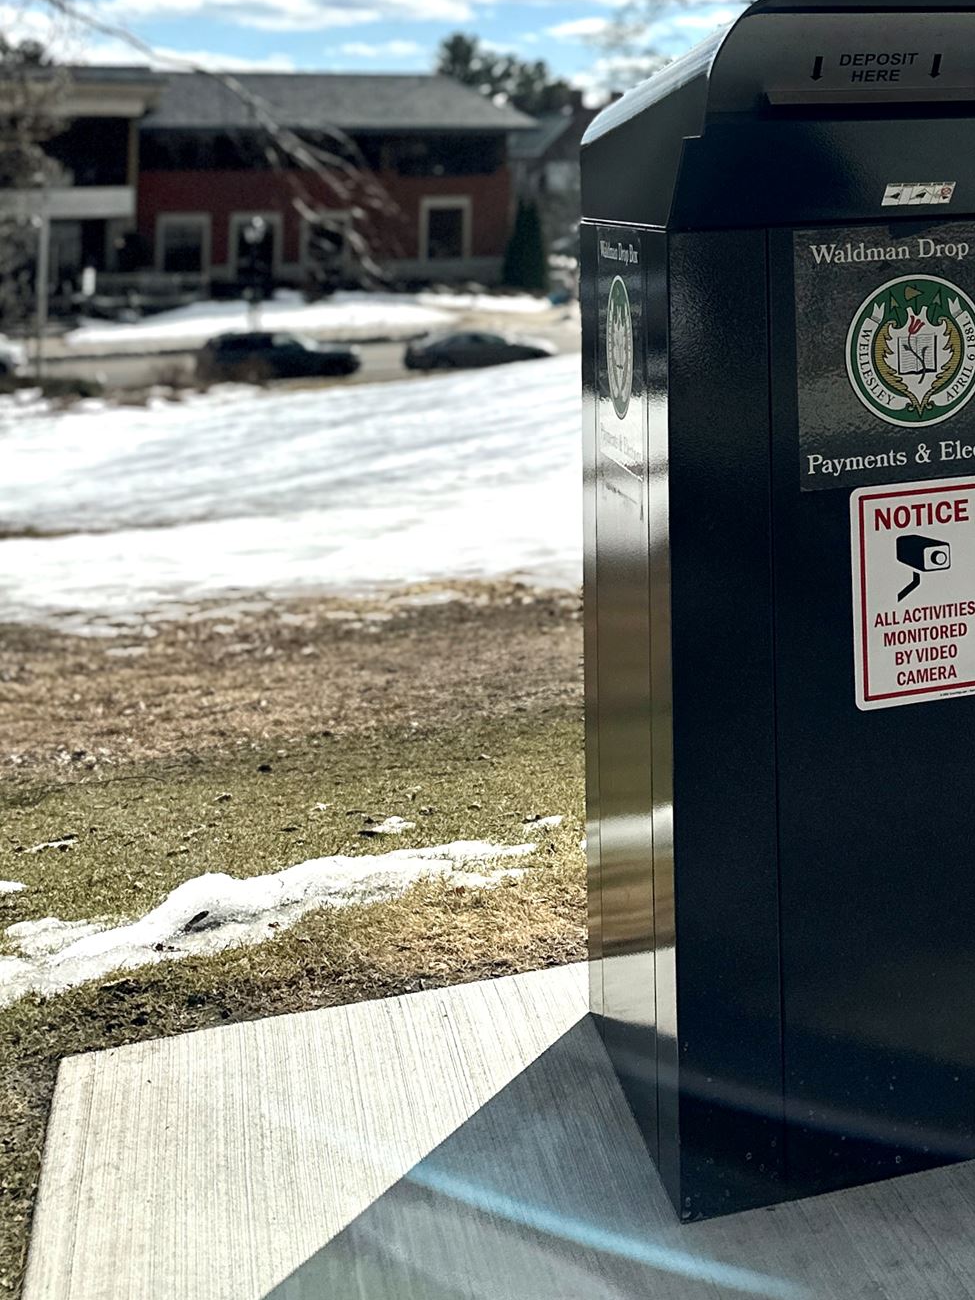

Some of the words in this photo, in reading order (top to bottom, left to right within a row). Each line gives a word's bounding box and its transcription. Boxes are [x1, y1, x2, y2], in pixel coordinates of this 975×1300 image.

[840, 52, 919, 66] DEPOSIT
[851, 69, 900, 82] HERE
[809, 242, 910, 265] Waldman
[917, 238, 969, 260] Drop
[859, 328, 896, 406] WELLESLEY
[945, 365, 973, 402] APRIL
[966, 353, 975, 361] 6
[807, 449, 908, 477] Payments
[914, 442, 932, 464] &
[874, 499, 970, 531] NOTICE
[874, 612, 900, 628] ALL
[903, 600, 975, 624] ACTIVITIES
[883, 622, 968, 647] MONITORED
[895, 650, 914, 666] BY
[915, 644, 958, 663] VIDEO
[896, 664, 957, 686] CAMERA
